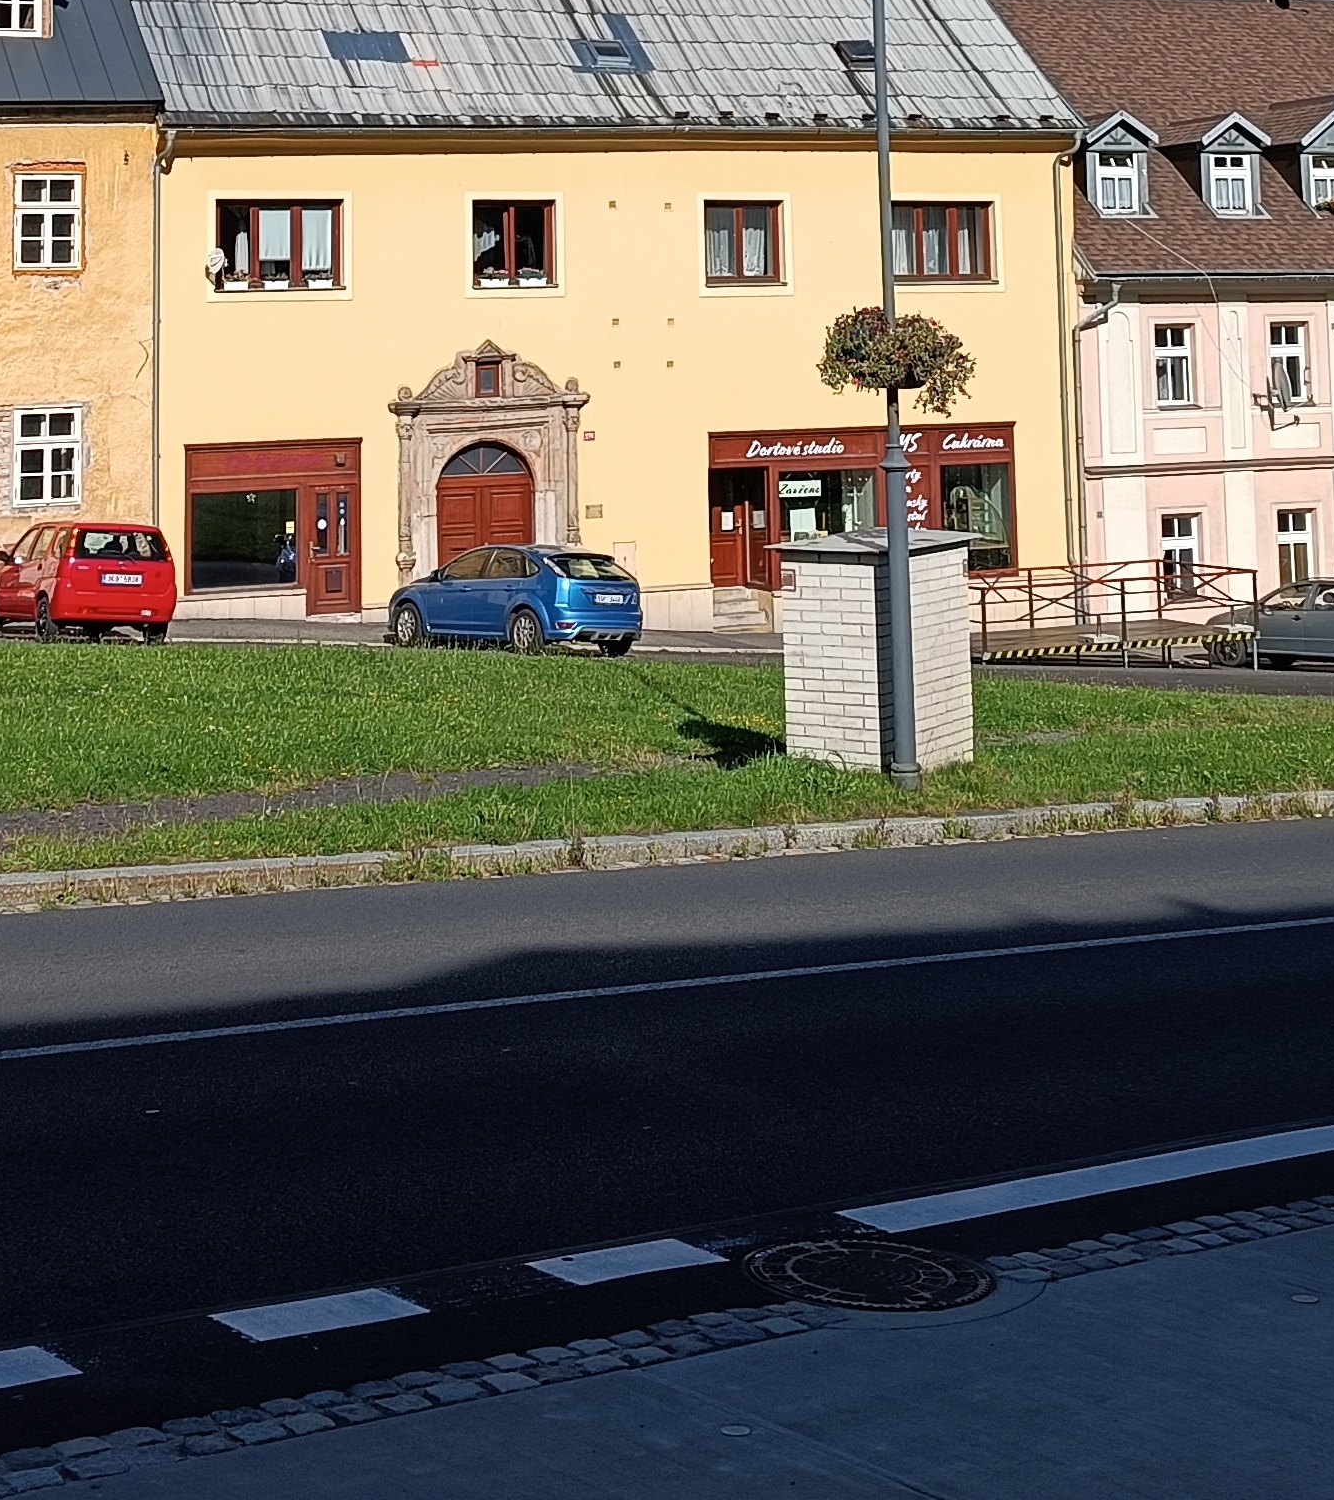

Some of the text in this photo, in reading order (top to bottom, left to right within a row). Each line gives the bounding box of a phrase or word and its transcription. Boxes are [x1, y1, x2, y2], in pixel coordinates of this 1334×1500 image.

[746, 437, 845, 458] Dortové studio
[942, 433, 1005, 450] Cukrárna
